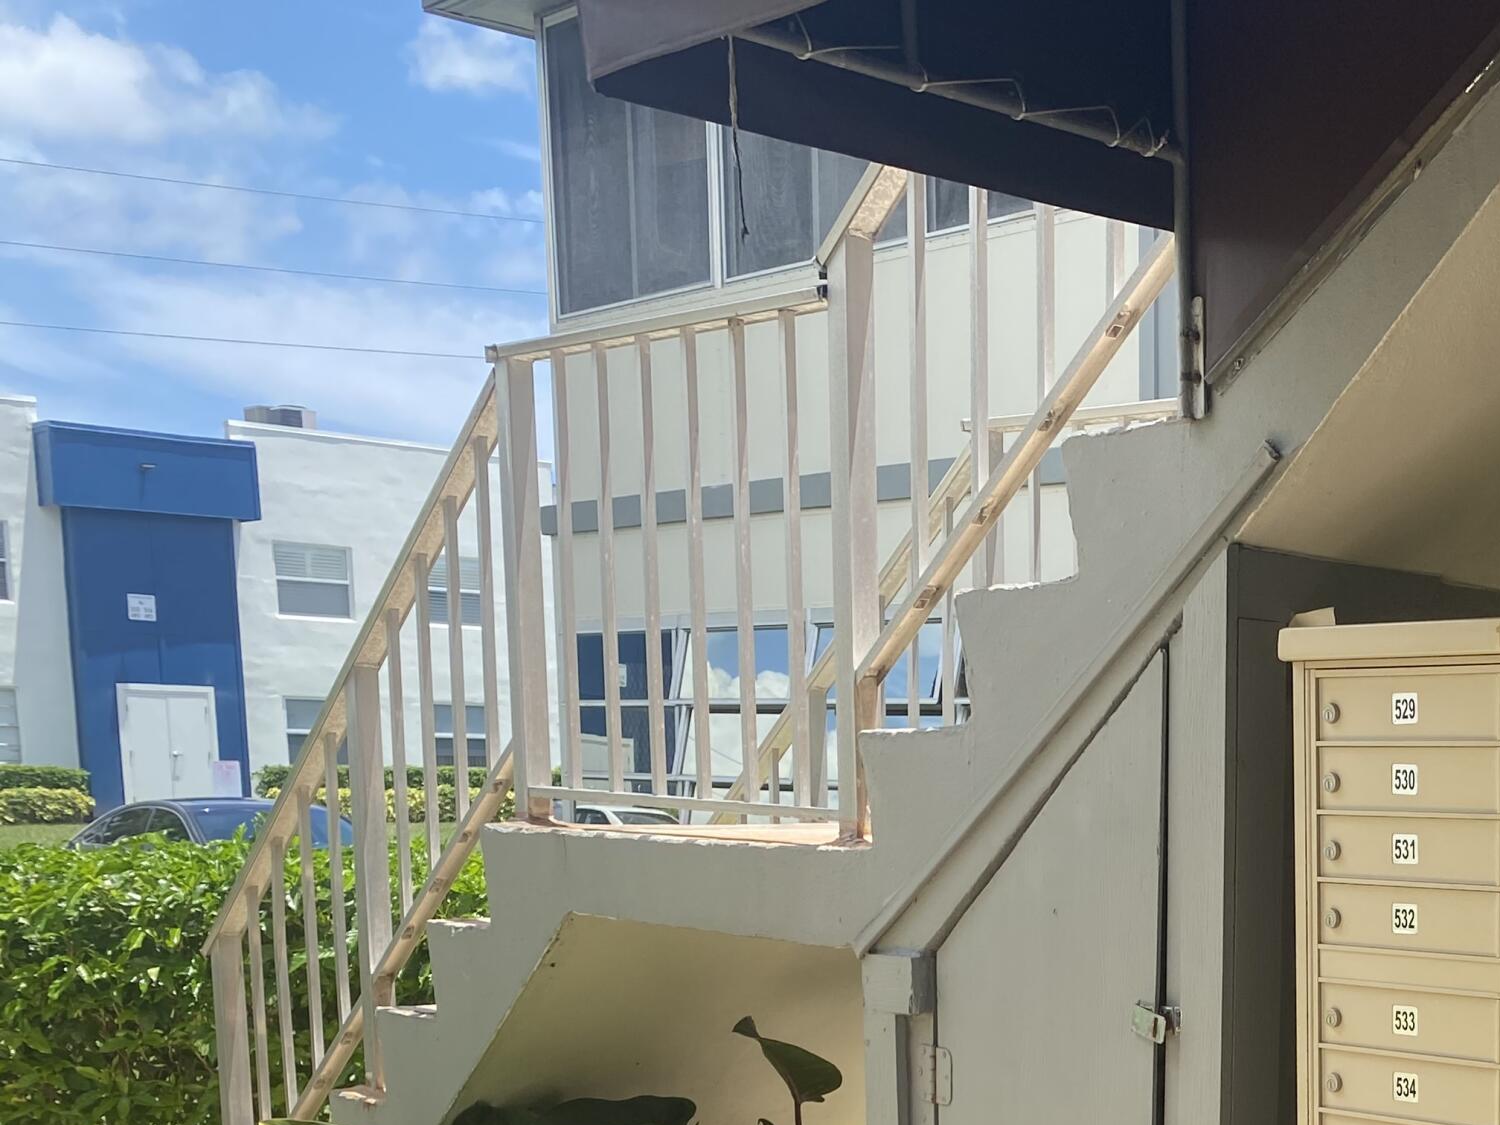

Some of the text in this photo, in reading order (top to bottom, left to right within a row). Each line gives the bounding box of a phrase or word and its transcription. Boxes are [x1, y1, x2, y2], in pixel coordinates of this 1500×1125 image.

[1395, 698, 1416, 720] 529
[1394, 769, 1416, 791] 530
[1394, 839, 1416, 860] 531
[1394, 908, 1415, 929] 532
[1394, 1010, 1416, 1032] 533
[1396, 1077, 1417, 1098] 534
